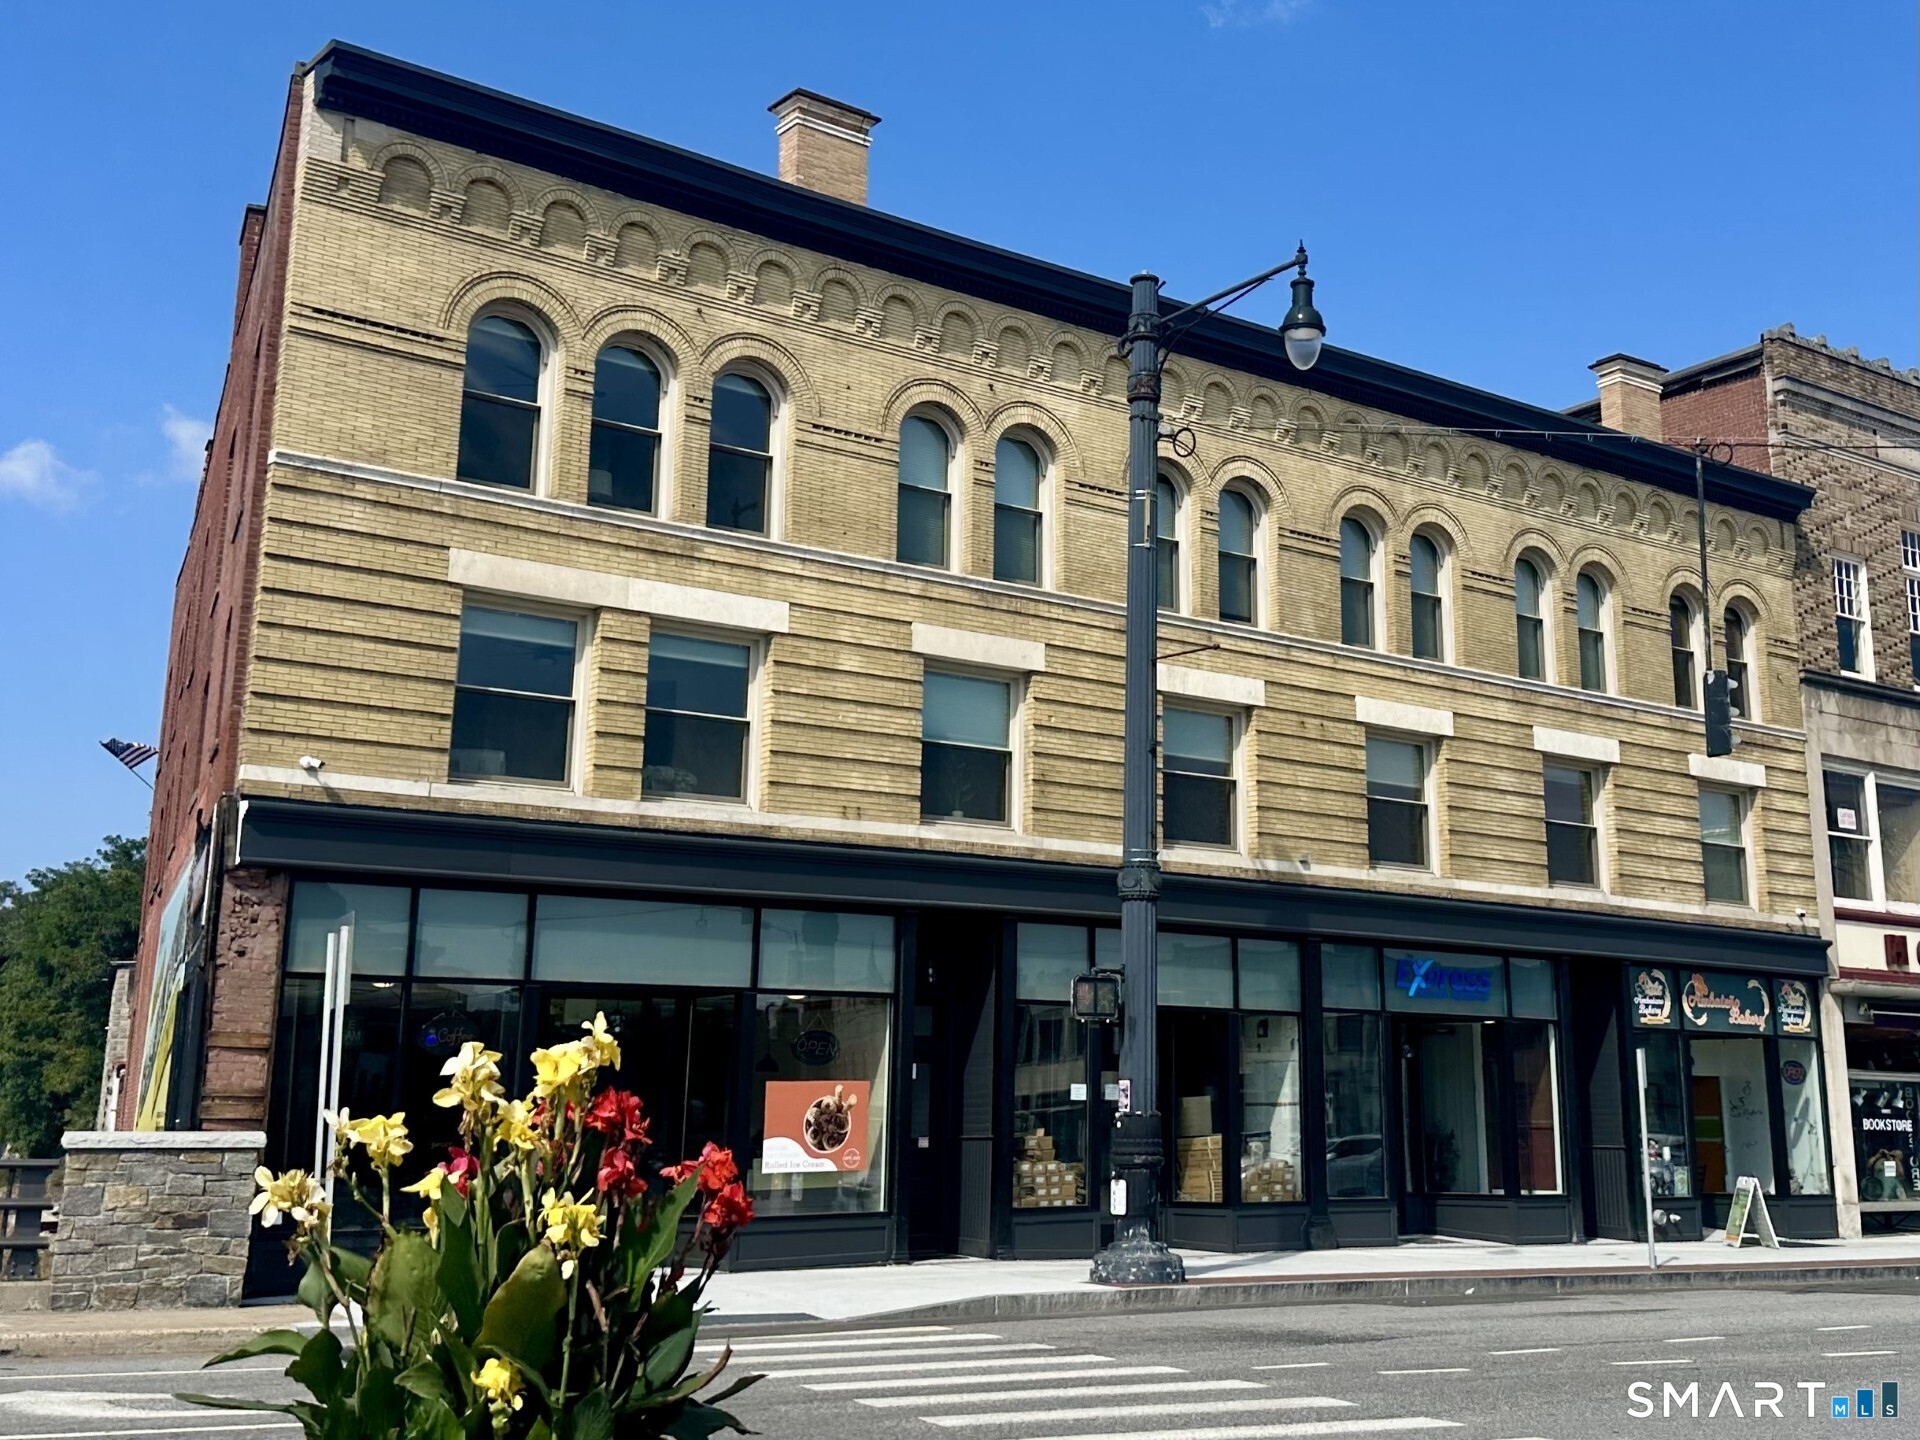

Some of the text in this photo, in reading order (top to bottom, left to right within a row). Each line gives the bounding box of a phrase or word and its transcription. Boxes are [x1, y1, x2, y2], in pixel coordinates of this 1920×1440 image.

[1729, 1006, 1766, 1031] Bakery
[796, 1037, 839, 1058] OPEN
[1862, 1118, 1913, 1132] BOOKSTORE
[765, 1160, 825, 1169] Rolled Ice Cream
